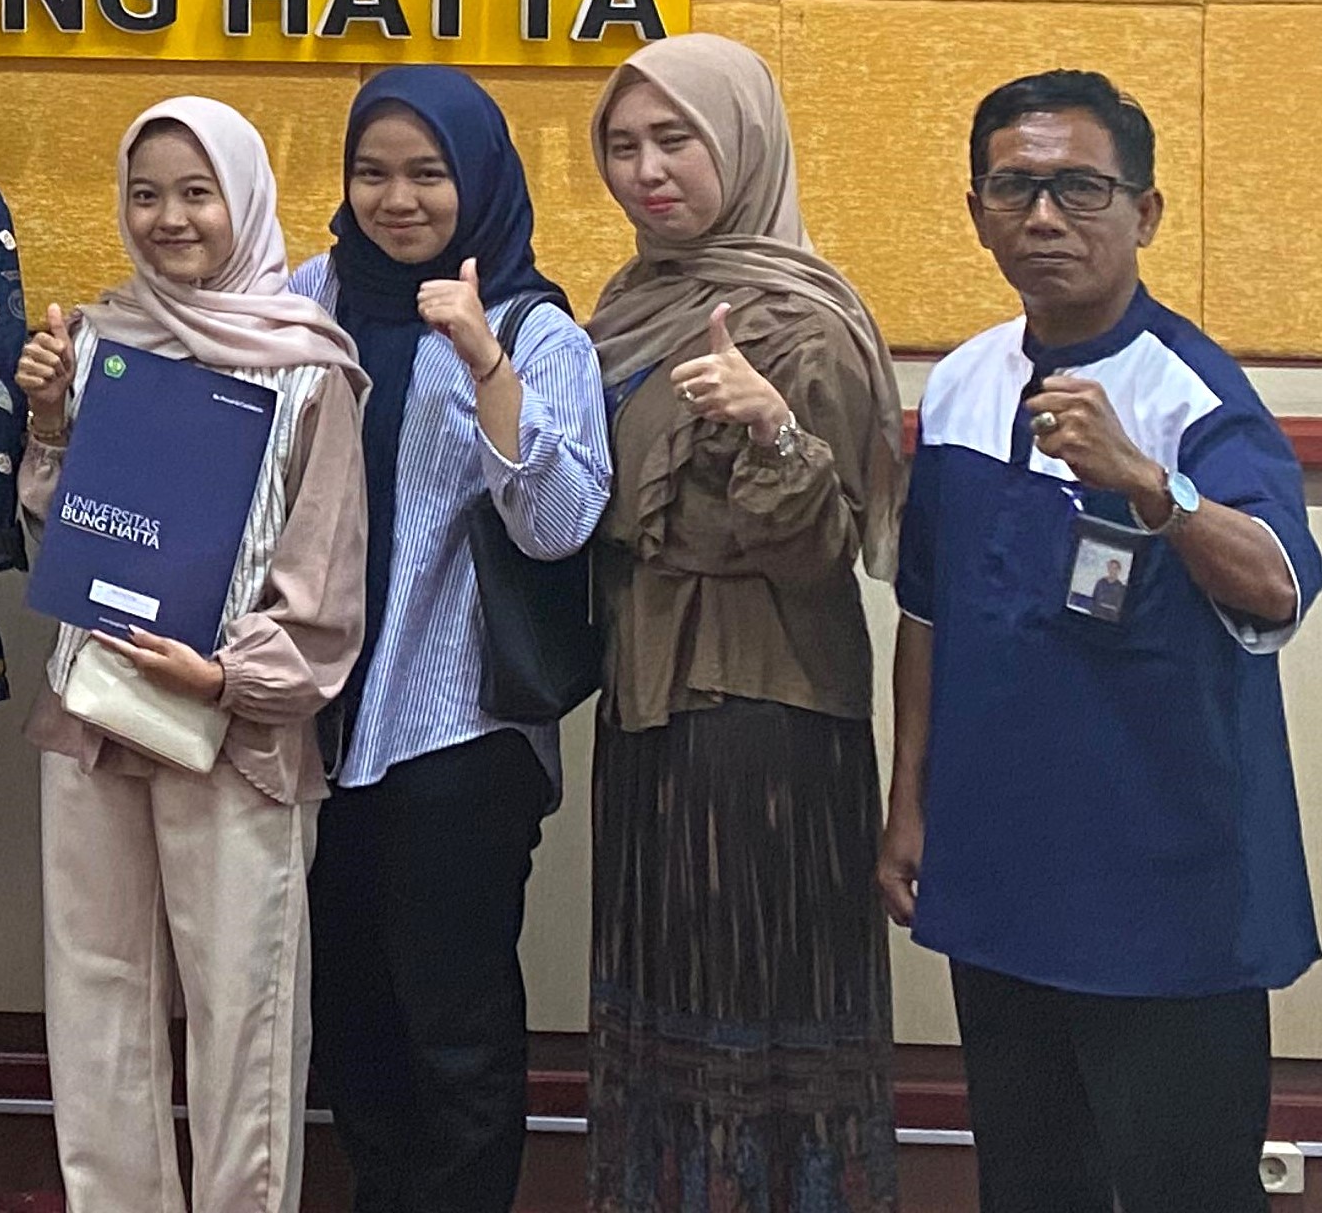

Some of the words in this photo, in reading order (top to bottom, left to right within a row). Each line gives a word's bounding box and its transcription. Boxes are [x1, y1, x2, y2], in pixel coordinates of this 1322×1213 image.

[61, 504, 108, 532] BUNG
[109, 519, 160, 550] HATTA
[64, 492, 162, 535] UNIVERSITAS
